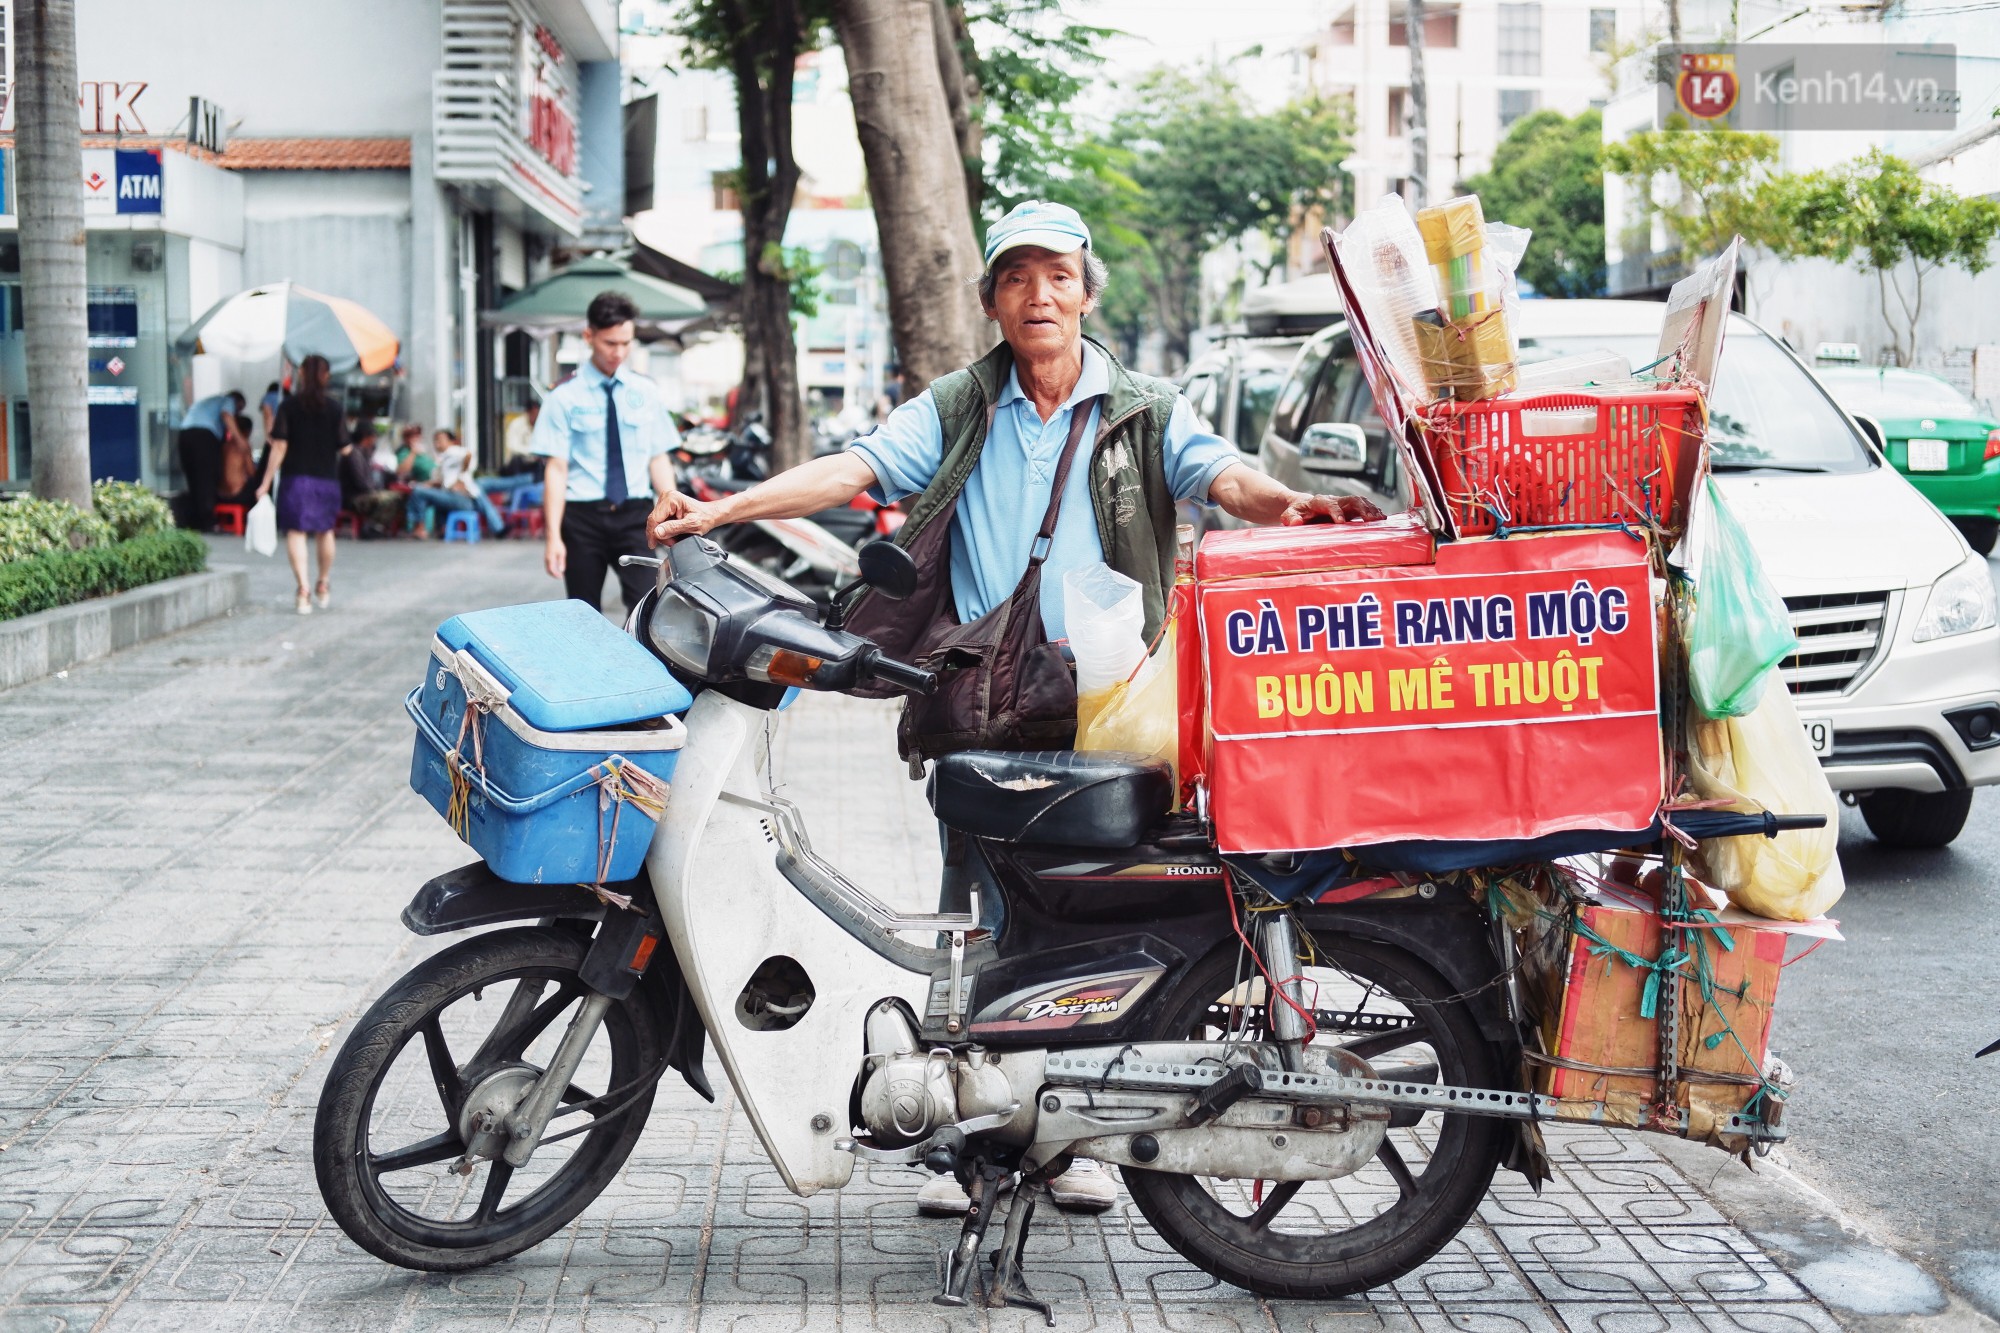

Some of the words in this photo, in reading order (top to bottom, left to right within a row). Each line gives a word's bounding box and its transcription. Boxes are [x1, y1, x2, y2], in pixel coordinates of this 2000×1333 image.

[119, 174, 161, 200] ATM
[1225, 598, 1289, 657] CÀ
[1296, 592, 1384, 653] PHÊ
[1394, 594, 1516, 648] RANG
[1526, 579, 1629, 647] MỘC
[1256, 663, 1374, 719] BUÔN
[1388, 657, 1455, 712] MÊ
[1467, 649, 1604, 712] THUỘT
[1020, 1000, 1118, 1021] DREAM
